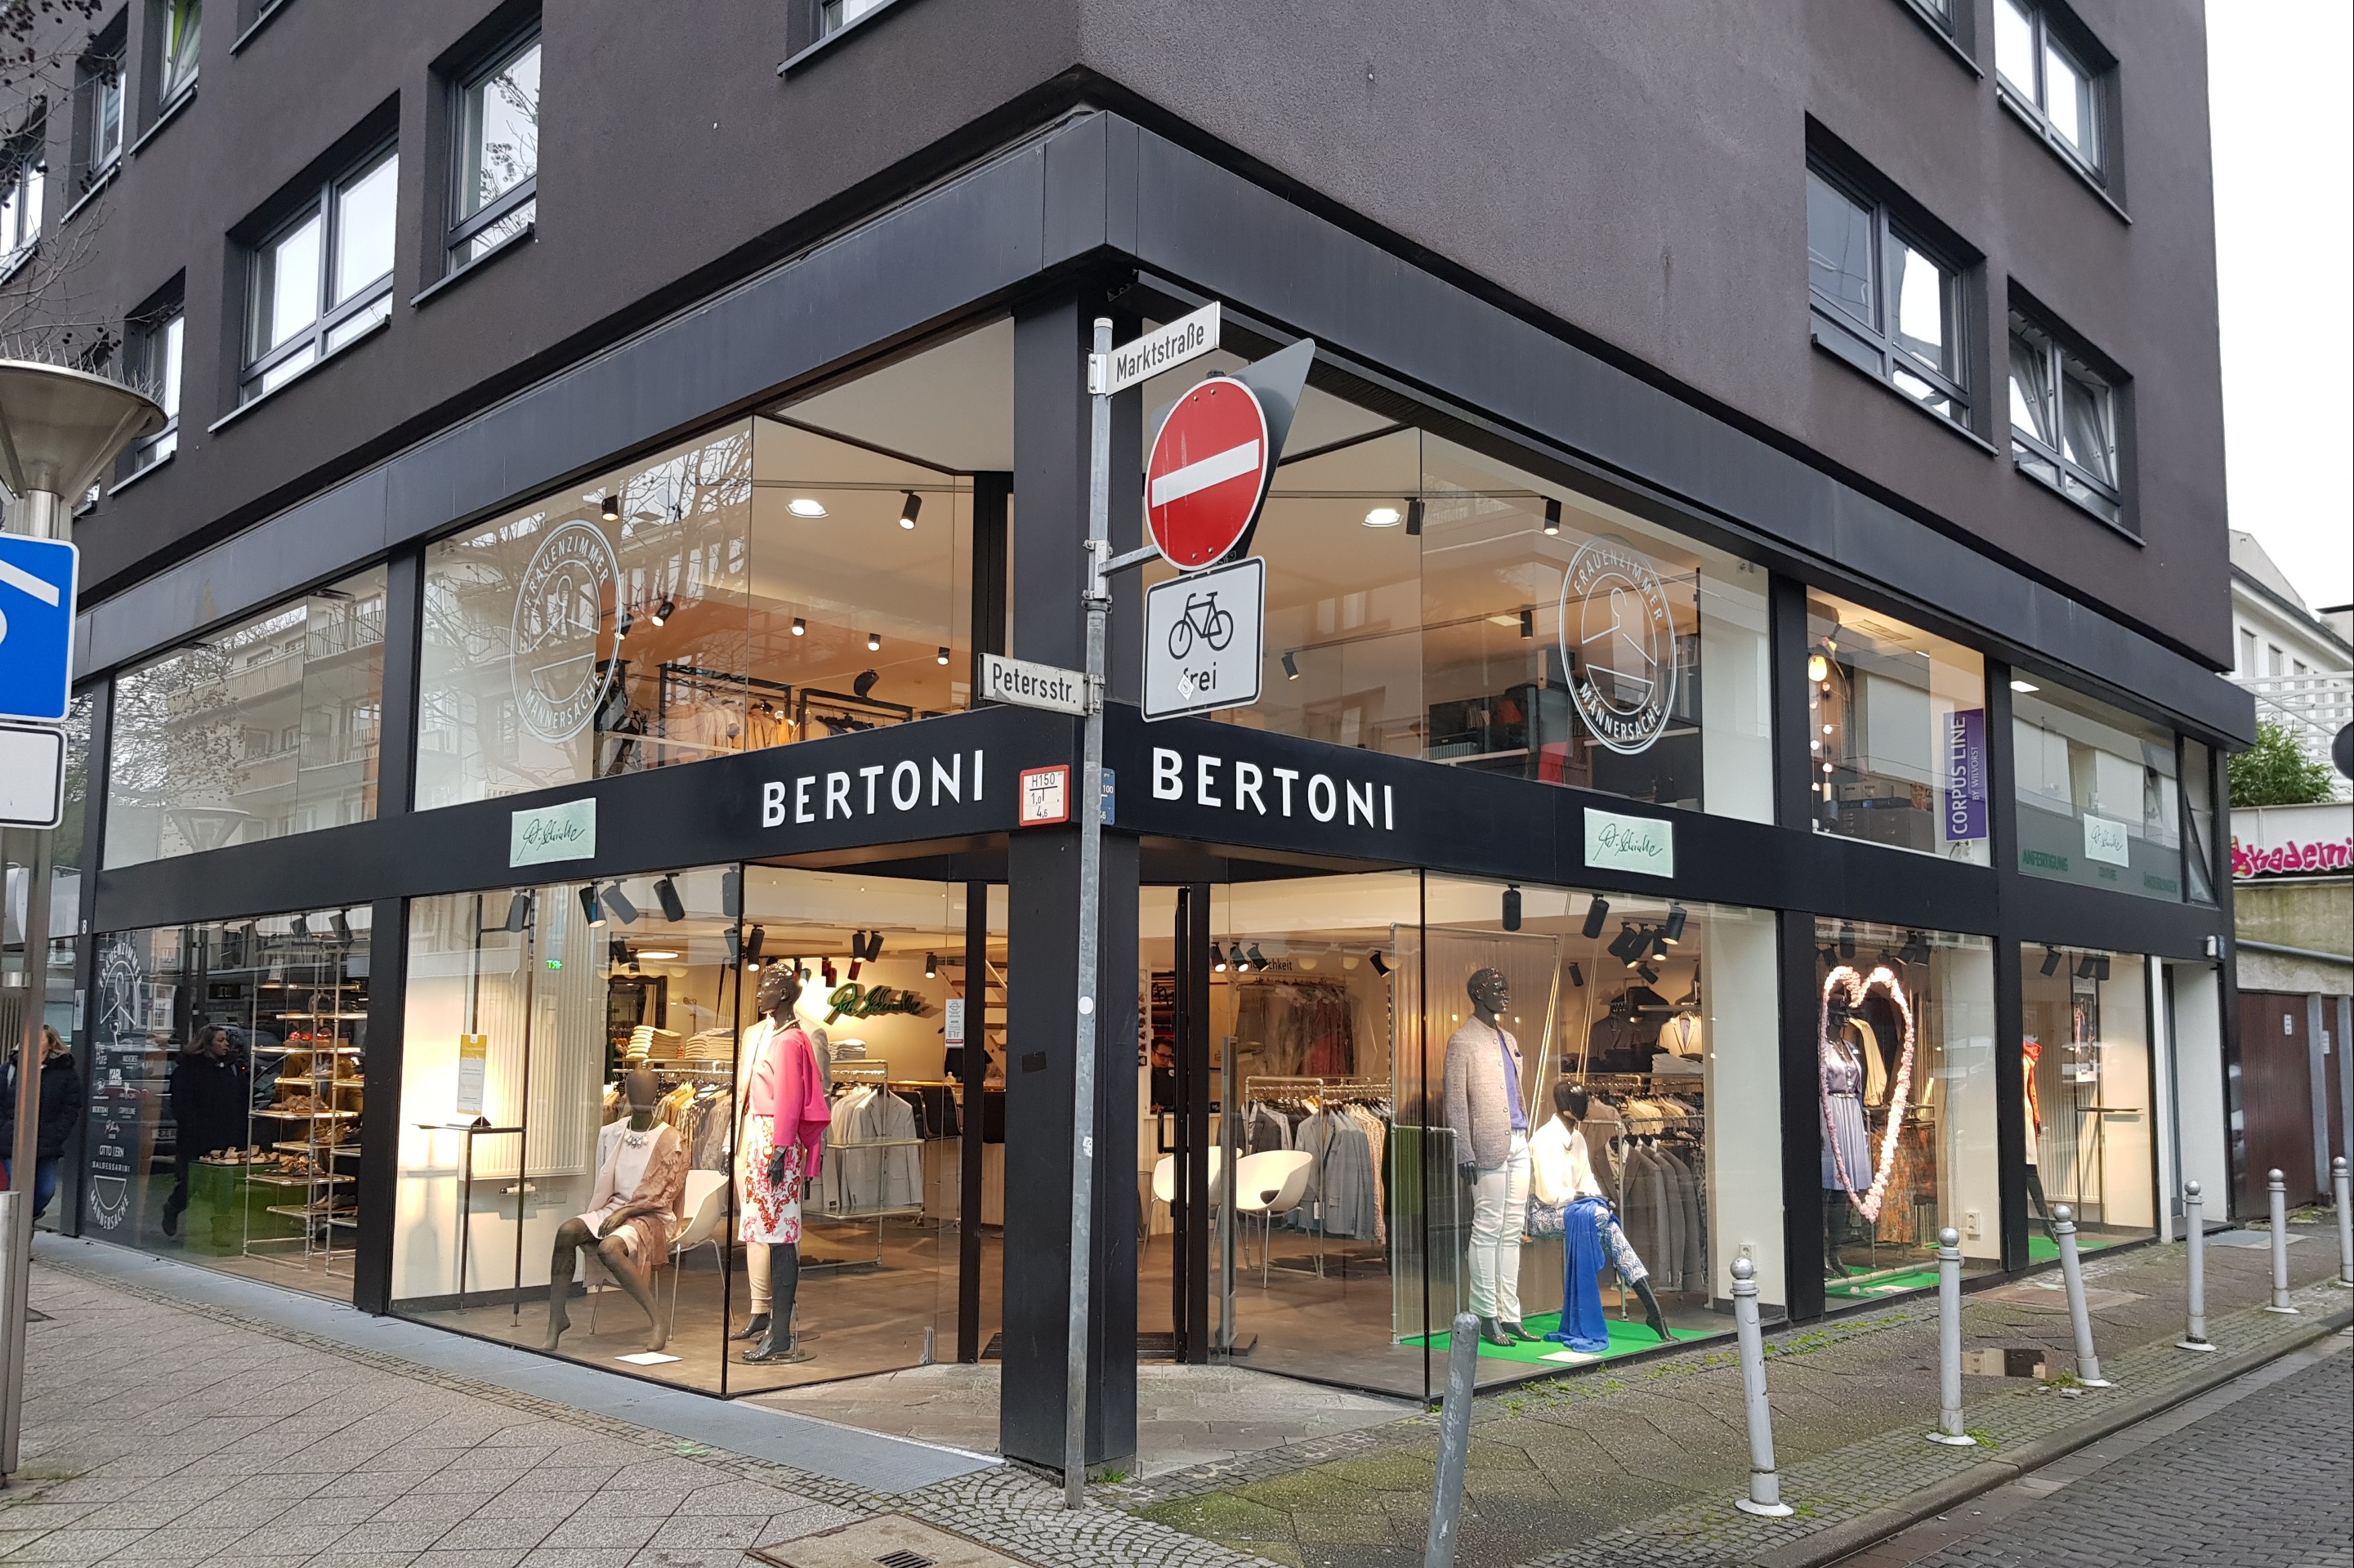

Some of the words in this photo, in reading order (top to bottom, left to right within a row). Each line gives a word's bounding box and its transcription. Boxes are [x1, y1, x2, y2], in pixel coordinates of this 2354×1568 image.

[1116, 322, 1204, 382] Marktstraße
[524, 536, 610, 606] FRAUENZIMMER
[1574, 548, 1663, 621] FRAUENZIMMER
[523, 672, 602, 730] MÄNNERSACHE
[993, 662, 1076, 704] Petersstr.
[1579, 681, 1661, 741] MÄNNERSACHE
[1950, 716, 1967, 760] LINE
[762, 749, 983, 828] BERTONI
[1031, 773, 1056, 787] H150
[1153, 747, 1393, 830] BERTONI
[1971, 745, 1979, 788] WILVORST
[1951, 766, 1968, 834] CORPUS
[1972, 790, 1980, 801] BY
[82, 919, 87, 935] 8
[99, 942, 142, 988] FRAUENZIMMER
[92, 1160, 132, 1173] BALDESSARINI
[99, 1145, 113, 1157] OTTO
[90, 1189, 129, 1230] MÄNNERSACHE
